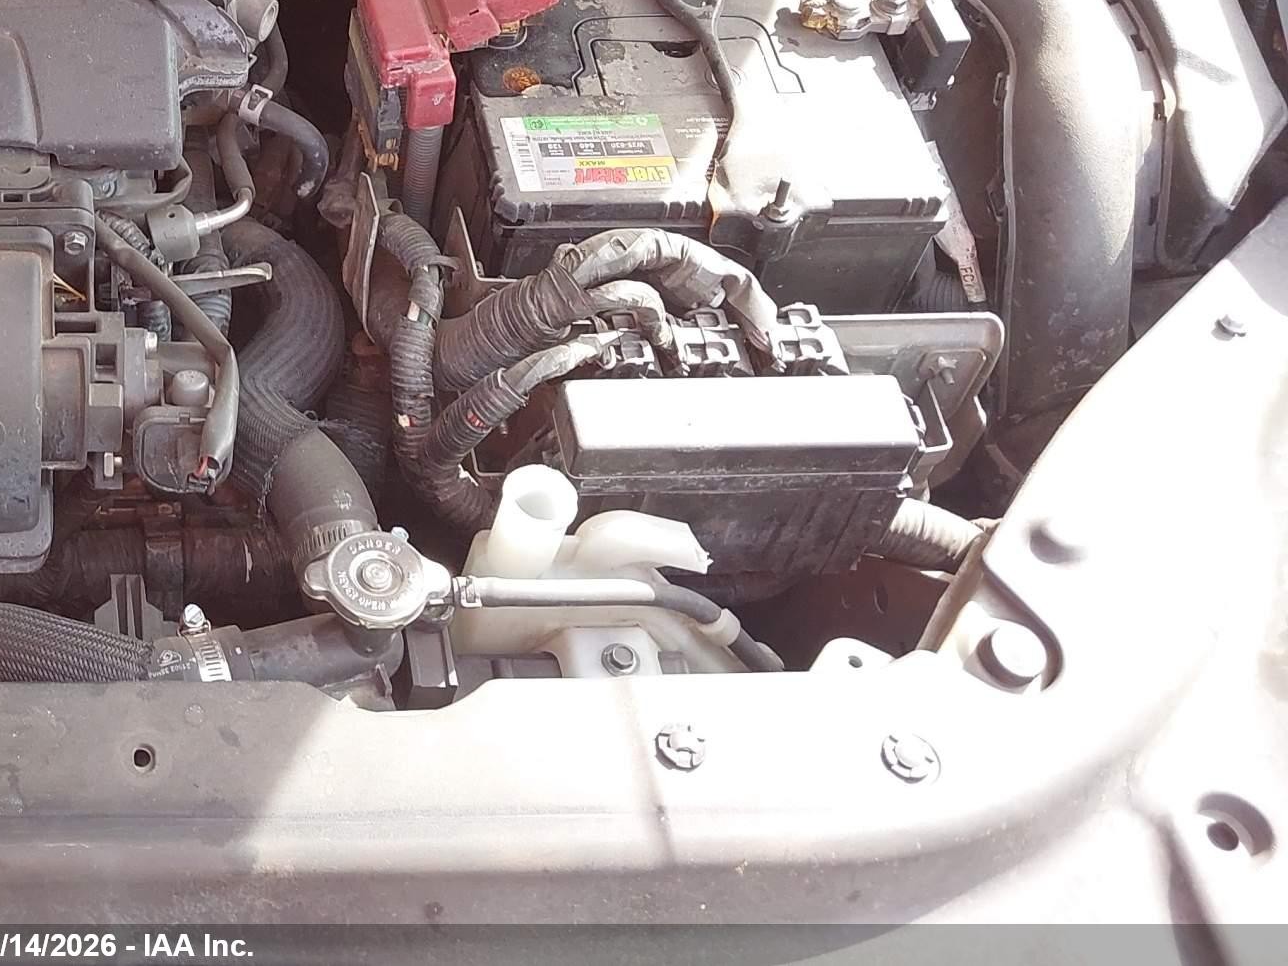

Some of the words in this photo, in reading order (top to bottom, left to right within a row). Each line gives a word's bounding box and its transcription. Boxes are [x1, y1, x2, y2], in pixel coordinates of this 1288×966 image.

[578, 159, 606, 167] MAXX
[575, 166, 670, 185] EverStart
[349, 539, 402, 555] DANGER
